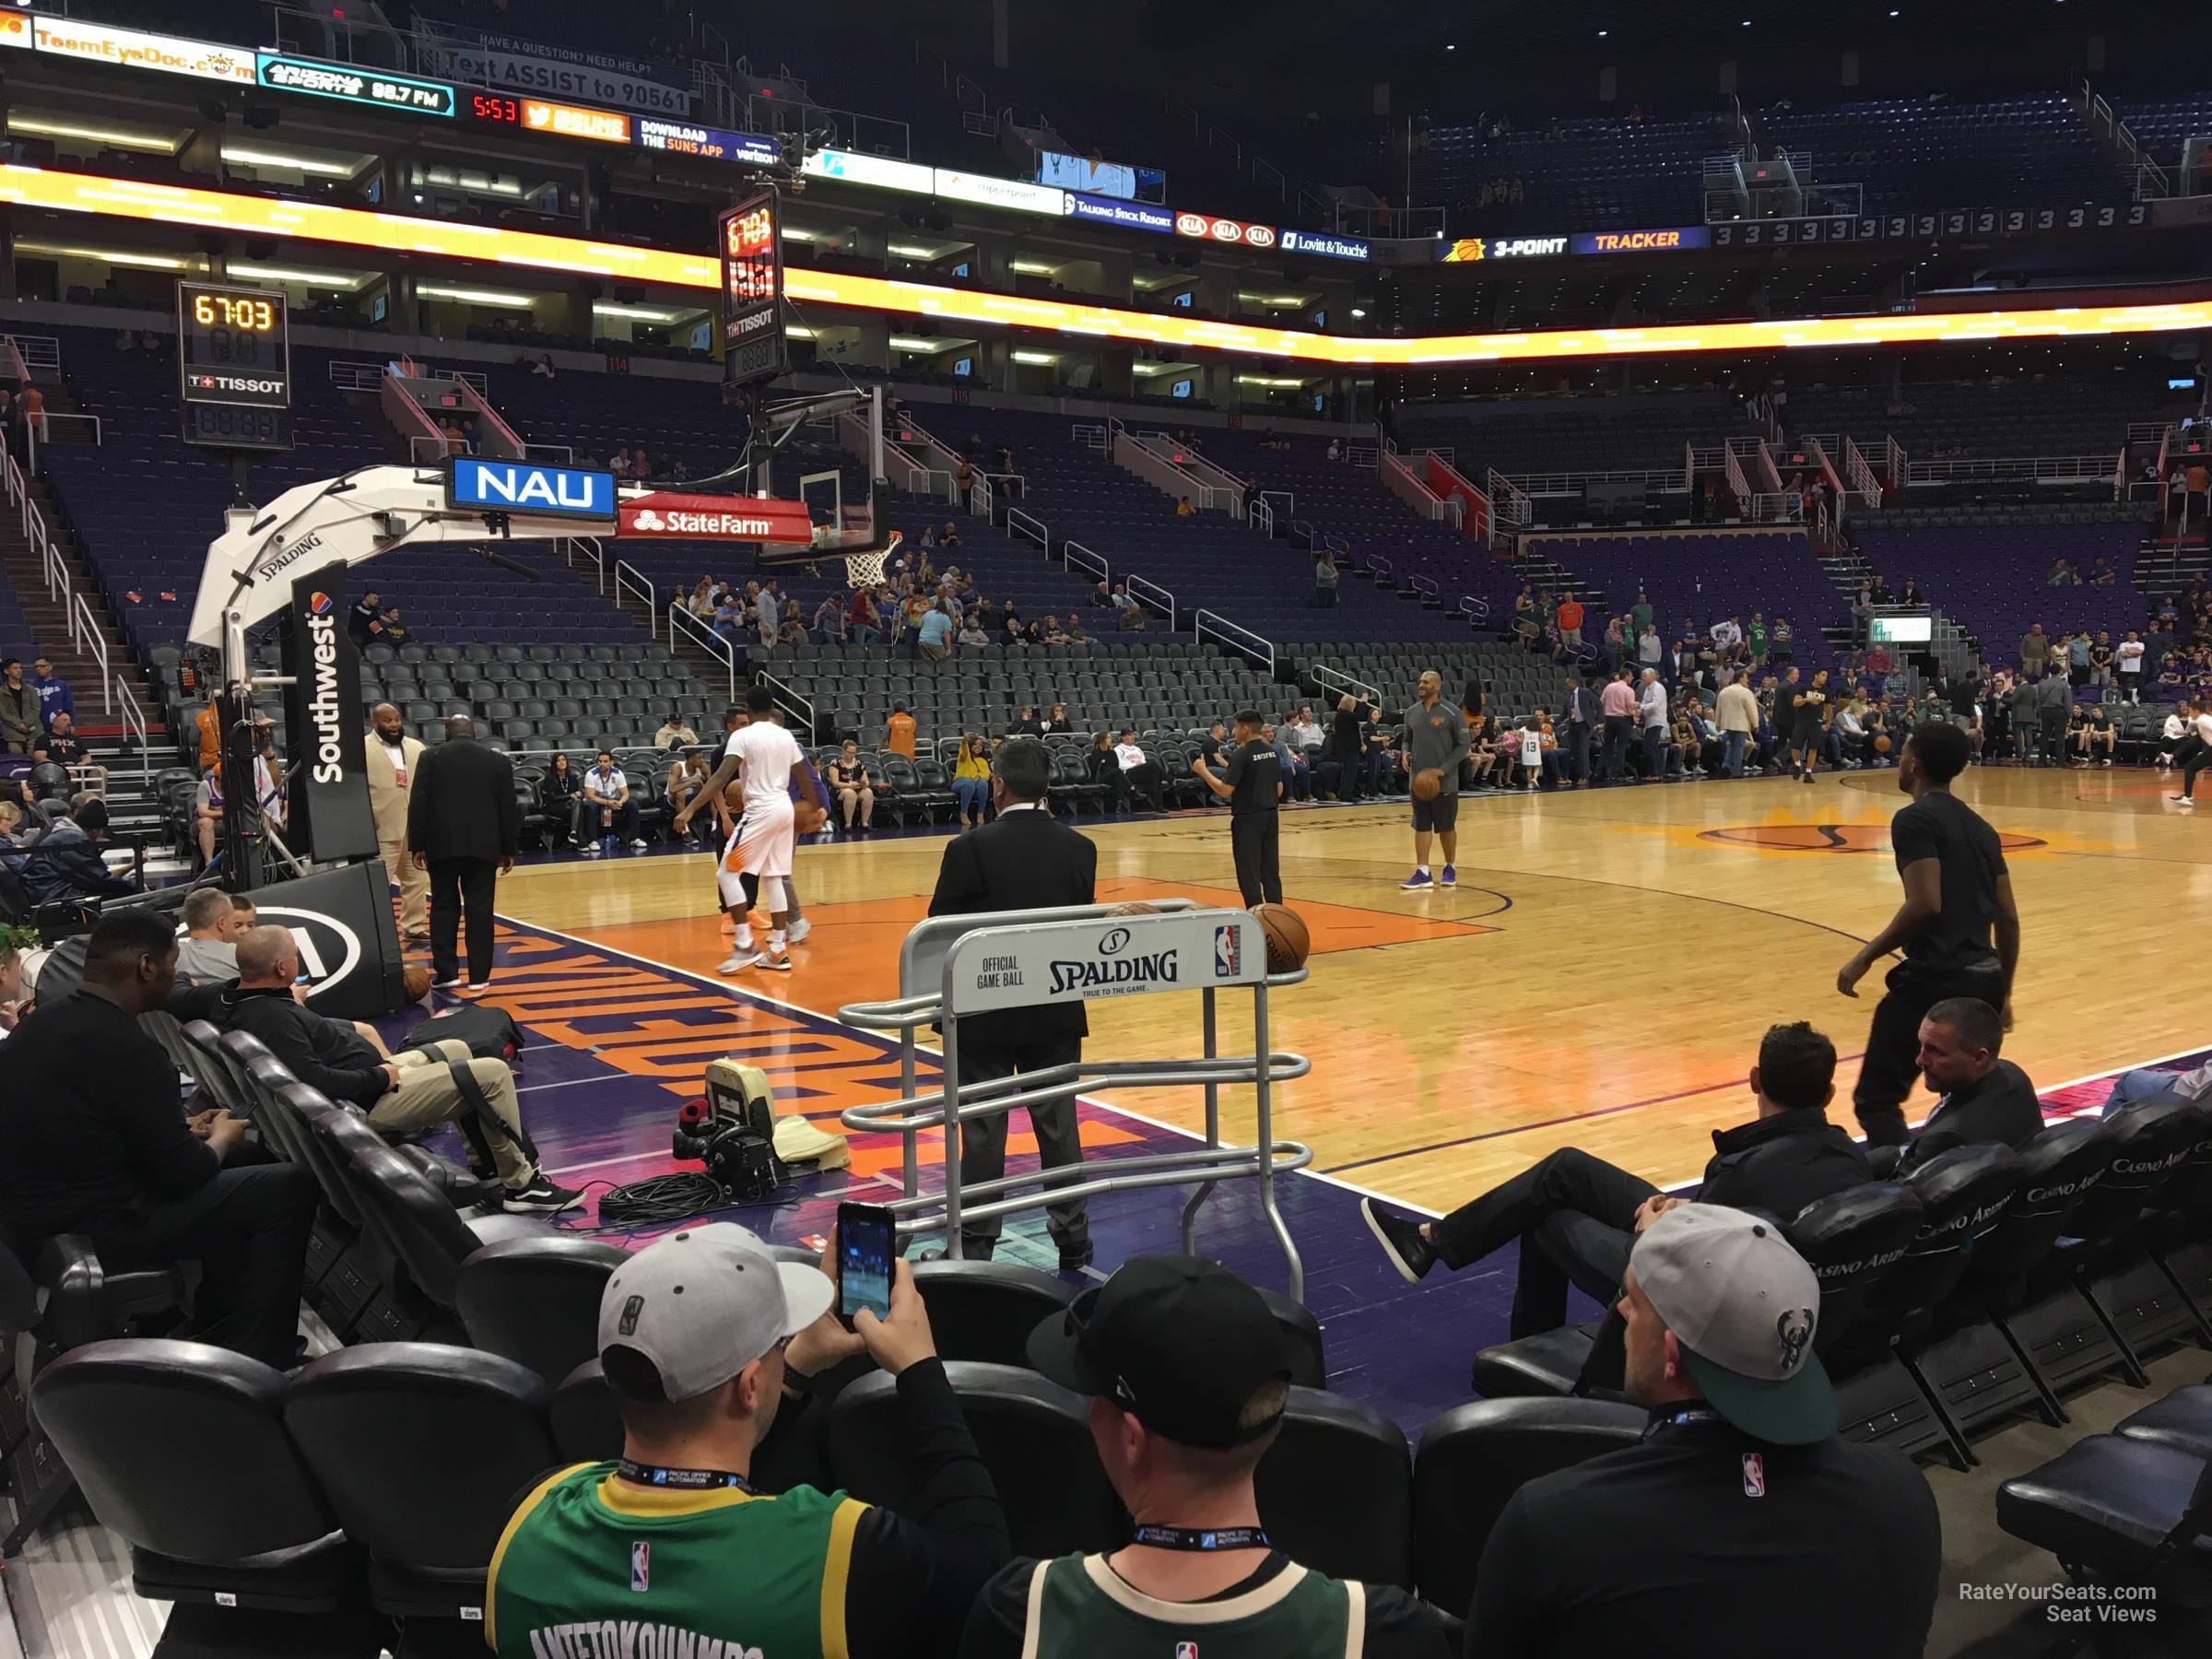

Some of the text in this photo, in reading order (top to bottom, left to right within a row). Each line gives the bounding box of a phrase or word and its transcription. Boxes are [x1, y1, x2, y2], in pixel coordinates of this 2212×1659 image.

[480, 34, 652, 75] HAVE A QUESTION? NEED HELP?
[268, 65, 363, 88] ARIZONA
[272, 74, 359, 96] SPORTS
[446, 50, 686, 111] Text ASSIST to 90561
[371, 82, 439, 108] 98.7 FM
[473, 96, 515, 122] 5:53
[641, 120, 707, 143] DOWNLOAD
[641, 134, 724, 159] THE SUNS APP
[736, 148, 774, 164] verizon
[1716, 206, 2146, 245] 3 3 3 3 3 3 3 3 3 3 3 3 3 3 3
[1298, 236, 1325, 252] Lovitt
[1335, 241, 1369, 258] Touché
[1494, 231, 1679, 256] 3-POINT TRACKER
[195, 295, 273, 330] 67:03
[739, 309, 773, 333] TISSOT
[216, 376, 284, 394] TISSOT
[477, 465, 593, 509] NAU
[258, 532, 324, 582] SPALDING
[308, 615, 343, 783] Southwest
[1526, 741, 1536, 753] 13
[982, 956, 1018, 972] OFFICIAL
[1050, 949, 1178, 995] SPALDING
[977, 971, 1025, 990] GAME BALL
[1082, 989, 1100, 997] TRUE
[2112, 1159, 2161, 1173] CASINO
[1864, 1246, 1909, 1270] ARIZ
[668, 1476, 707, 1484] AUTOMATION
[530, 1619, 764, 1659] ANTETOKOUNM
